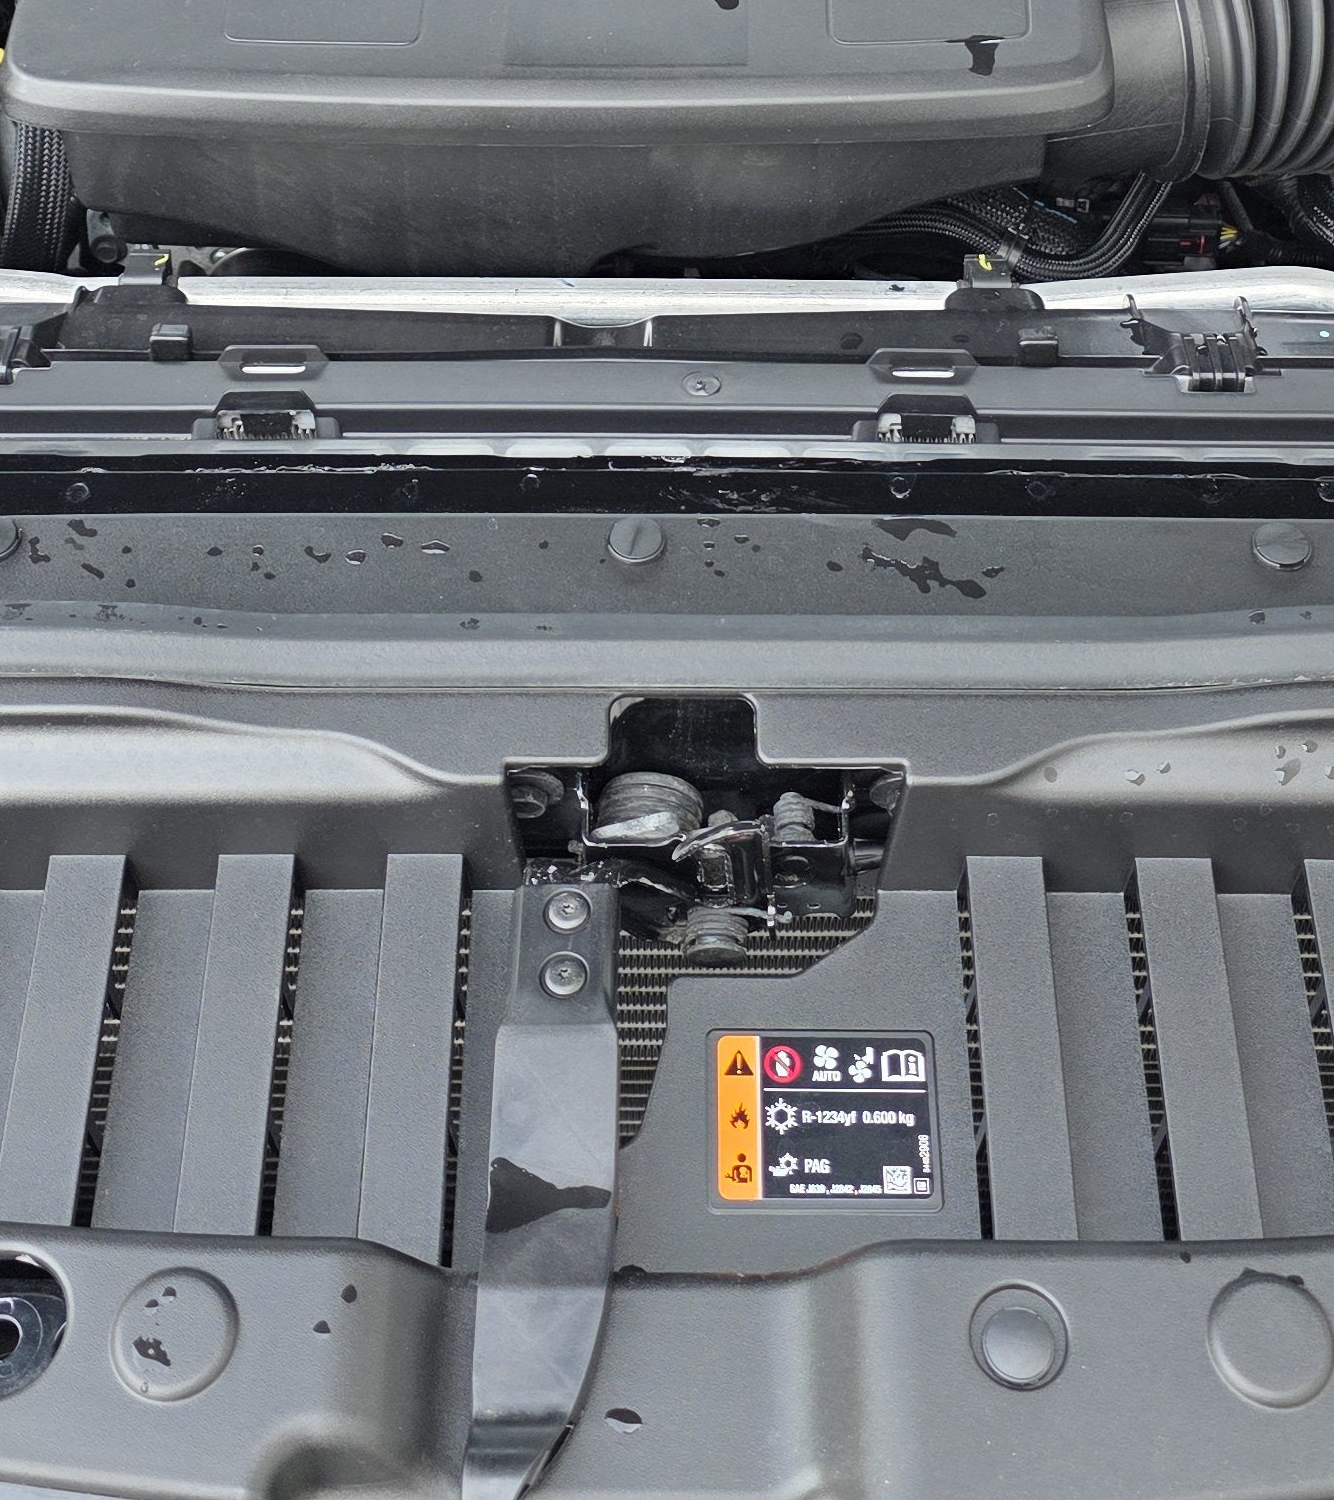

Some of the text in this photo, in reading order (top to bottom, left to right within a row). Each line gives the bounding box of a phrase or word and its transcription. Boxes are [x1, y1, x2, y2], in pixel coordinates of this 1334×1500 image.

[812, 1070, 842, 1082] AUTO
[801, 1110, 916, 1127] R-1234yf 0.600 kg
[804, 1158, 832, 1174] PAG
